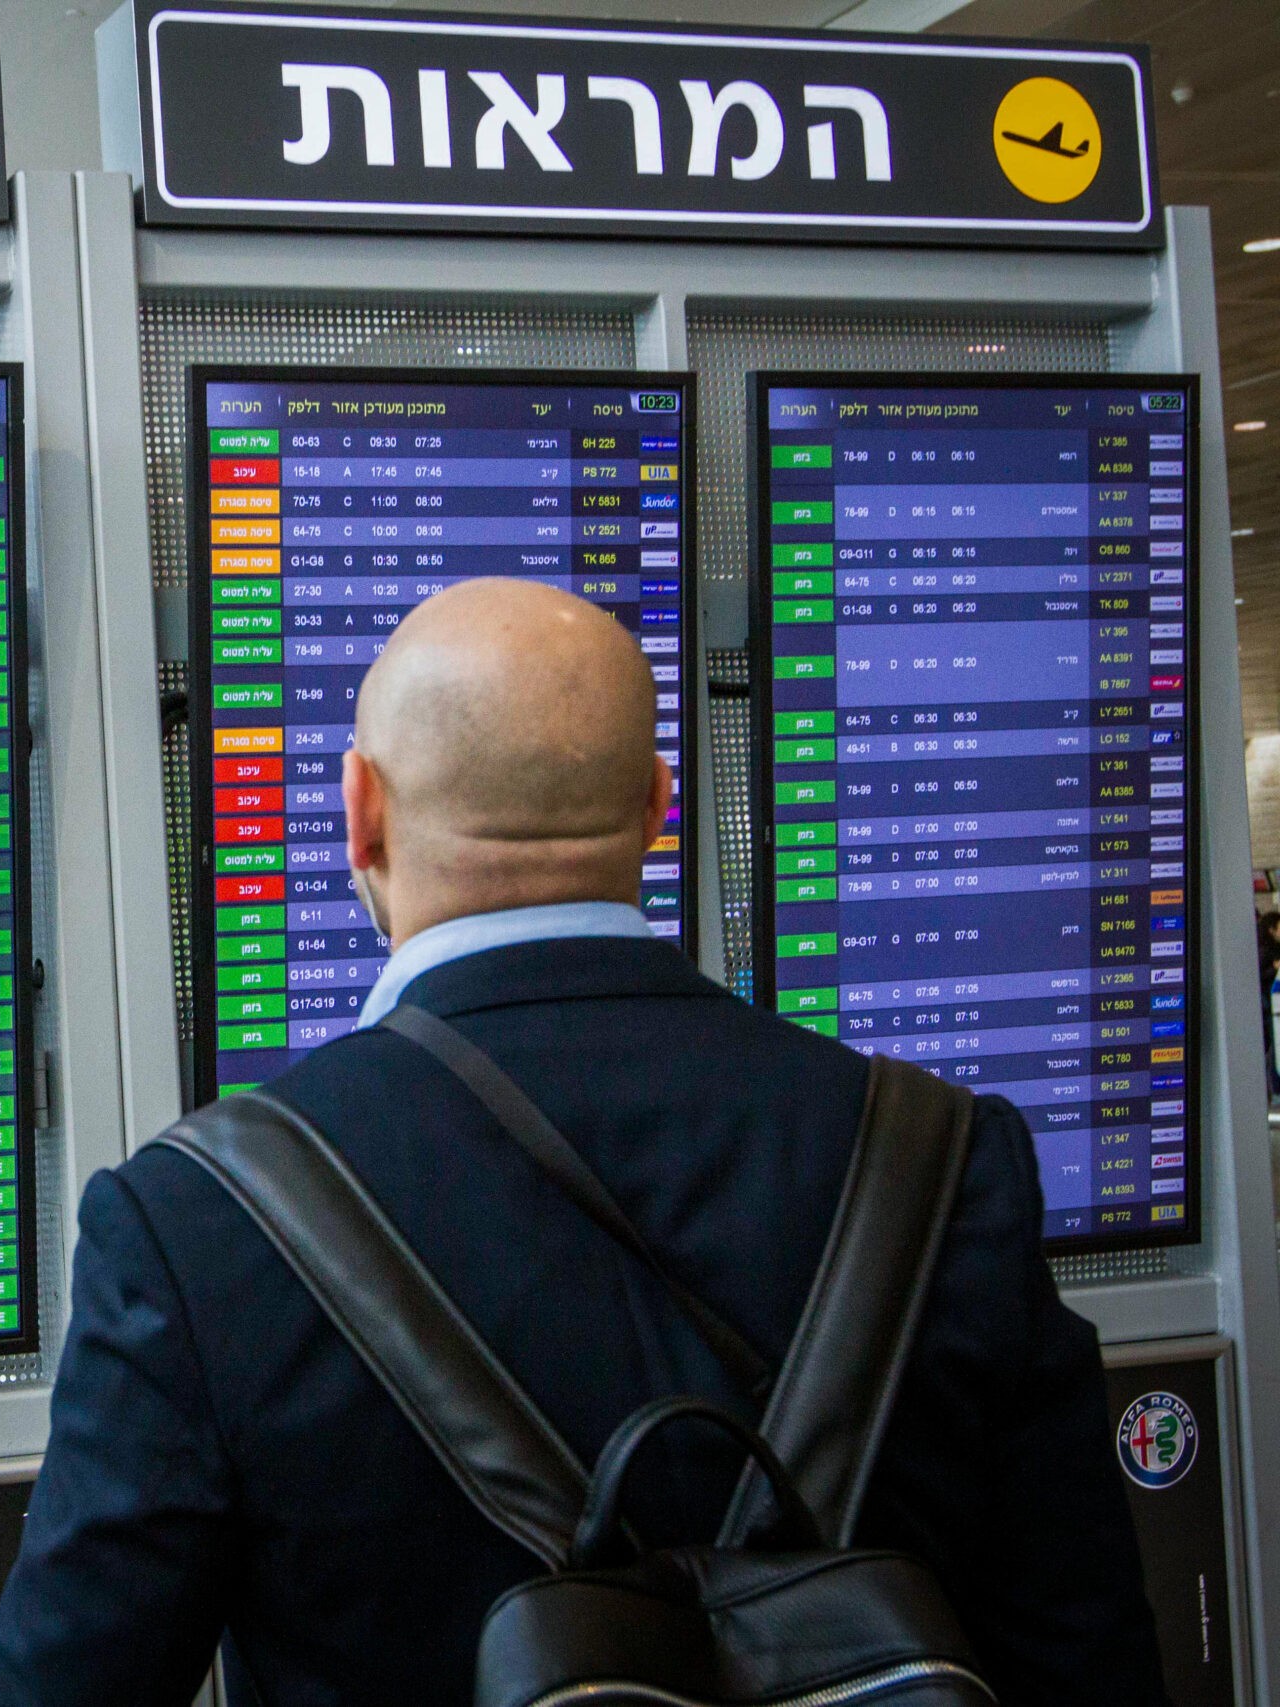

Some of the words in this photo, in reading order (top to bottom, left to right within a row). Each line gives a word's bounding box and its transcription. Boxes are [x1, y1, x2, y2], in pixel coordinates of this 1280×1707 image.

[282, 63, 892, 182] המראות
[220, 401, 262, 413] הערות
[288, 399, 320, 416] דלפק
[332, 402, 359, 414] אזור
[640, 397, 674, 409] 10:23
[1149, 396, 1180, 409] 05:22
[364, 403, 404, 417] מעודכן
[407, 403, 446, 417] מתוכנן
[532, 403, 552, 416] יעד
[593, 404, 623, 416] טיסה
[781, 404, 817, 416] הערות
[839, 402, 868, 419] דלפק
[878, 405, 902, 416] אזור
[906, 405, 942, 419] מעודכן
[944, 405, 979, 419] מתוכנן
[1054, 405, 1072, 417] יעד
[1108, 405, 1135, 416] טיסה
[292, 436, 320, 447] 60-63
[370, 437, 397, 447] 09:30
[415, 437, 442, 448] 07:25
[583, 438, 596, 449] 6H
[599, 438, 616, 449] 225
[234, 467, 257, 477] עיכוב
[294, 466, 320, 477] 15-18
[371, 466, 397, 477] 17:45
[415, 466, 442, 477] 07:45
[583, 467, 597, 478] PS
[599, 467, 617, 478] 772
[648, 467, 670, 479] UIA
[583, 496, 596, 507] LY
[598, 495, 621, 507] 5831
[521, 554, 559, 565] איסטנבול
[583, 554, 597, 564] TK
[599, 554, 616, 564] 865
[239, 885, 262, 895] עיכוב
[295, 880, 328, 892] G1-G4
[241, 913, 261, 925] בזמן
[300, 910, 322, 921] 6-11
[915, 932, 939, 943] 07:00
[955, 929, 979, 940] 07:00
[798, 940, 817, 951] בזמן
[843, 935, 877, 948] G9-G17
[1101, 947, 1114, 957] UA
[1115, 946, 1135, 956] 9470
[242, 1003, 262, 1014] בזמן
[291, 997, 335, 1009] G17-G19
[1101, 1108, 1113, 1118] TK
[1115, 1107, 1130, 1116] 811
[1116, 1211, 1131, 1221] 772
[1158, 1206, 1177, 1218] UIA
[1102, 1213, 1114, 1223] PS
[1121, 1403, 1145, 1444] ALFA
[1151, 1396, 1194, 1438] ROMEO
